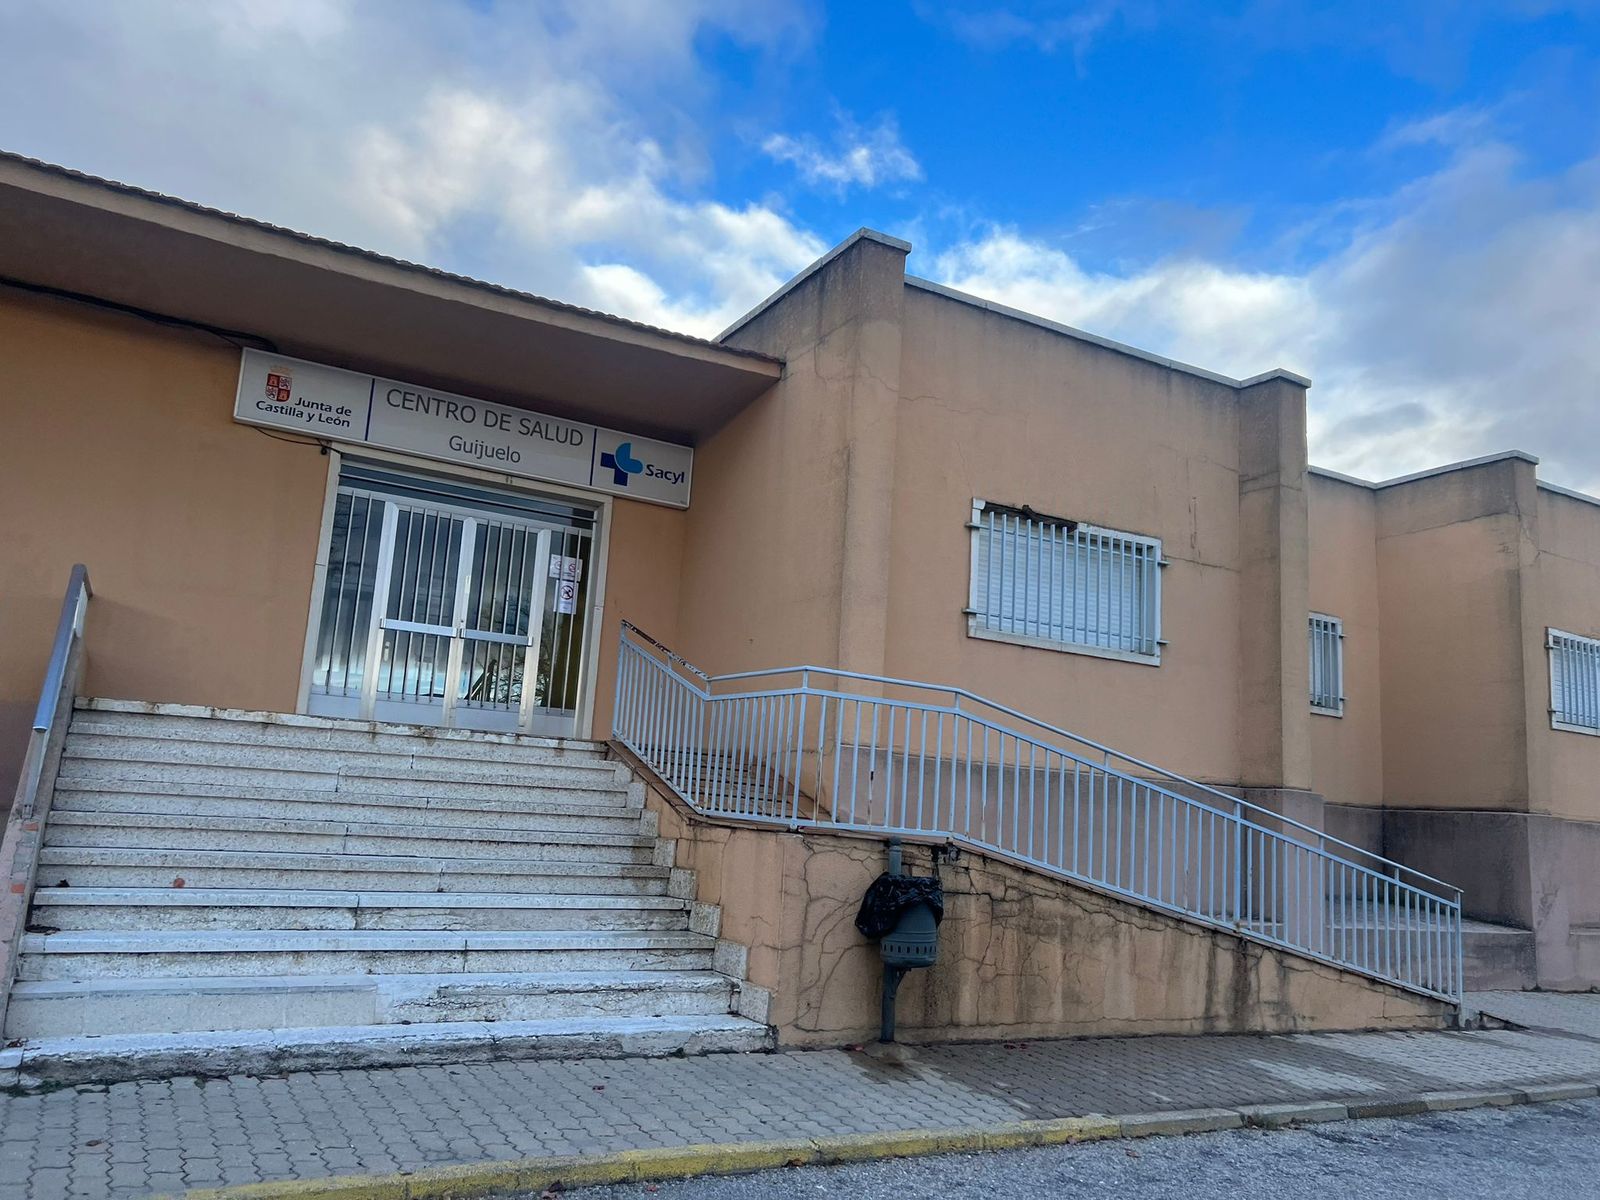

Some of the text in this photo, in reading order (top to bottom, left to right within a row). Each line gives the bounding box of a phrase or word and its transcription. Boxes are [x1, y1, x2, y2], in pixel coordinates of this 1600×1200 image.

[256, 400, 350, 428] Castilla y León
[295, 397, 352, 417] Junta de
[386, 388, 584, 446] CENTRO DE SALUD
[449, 435, 521, 463] Guijuelo
[645, 464, 685, 484] Sacyl
